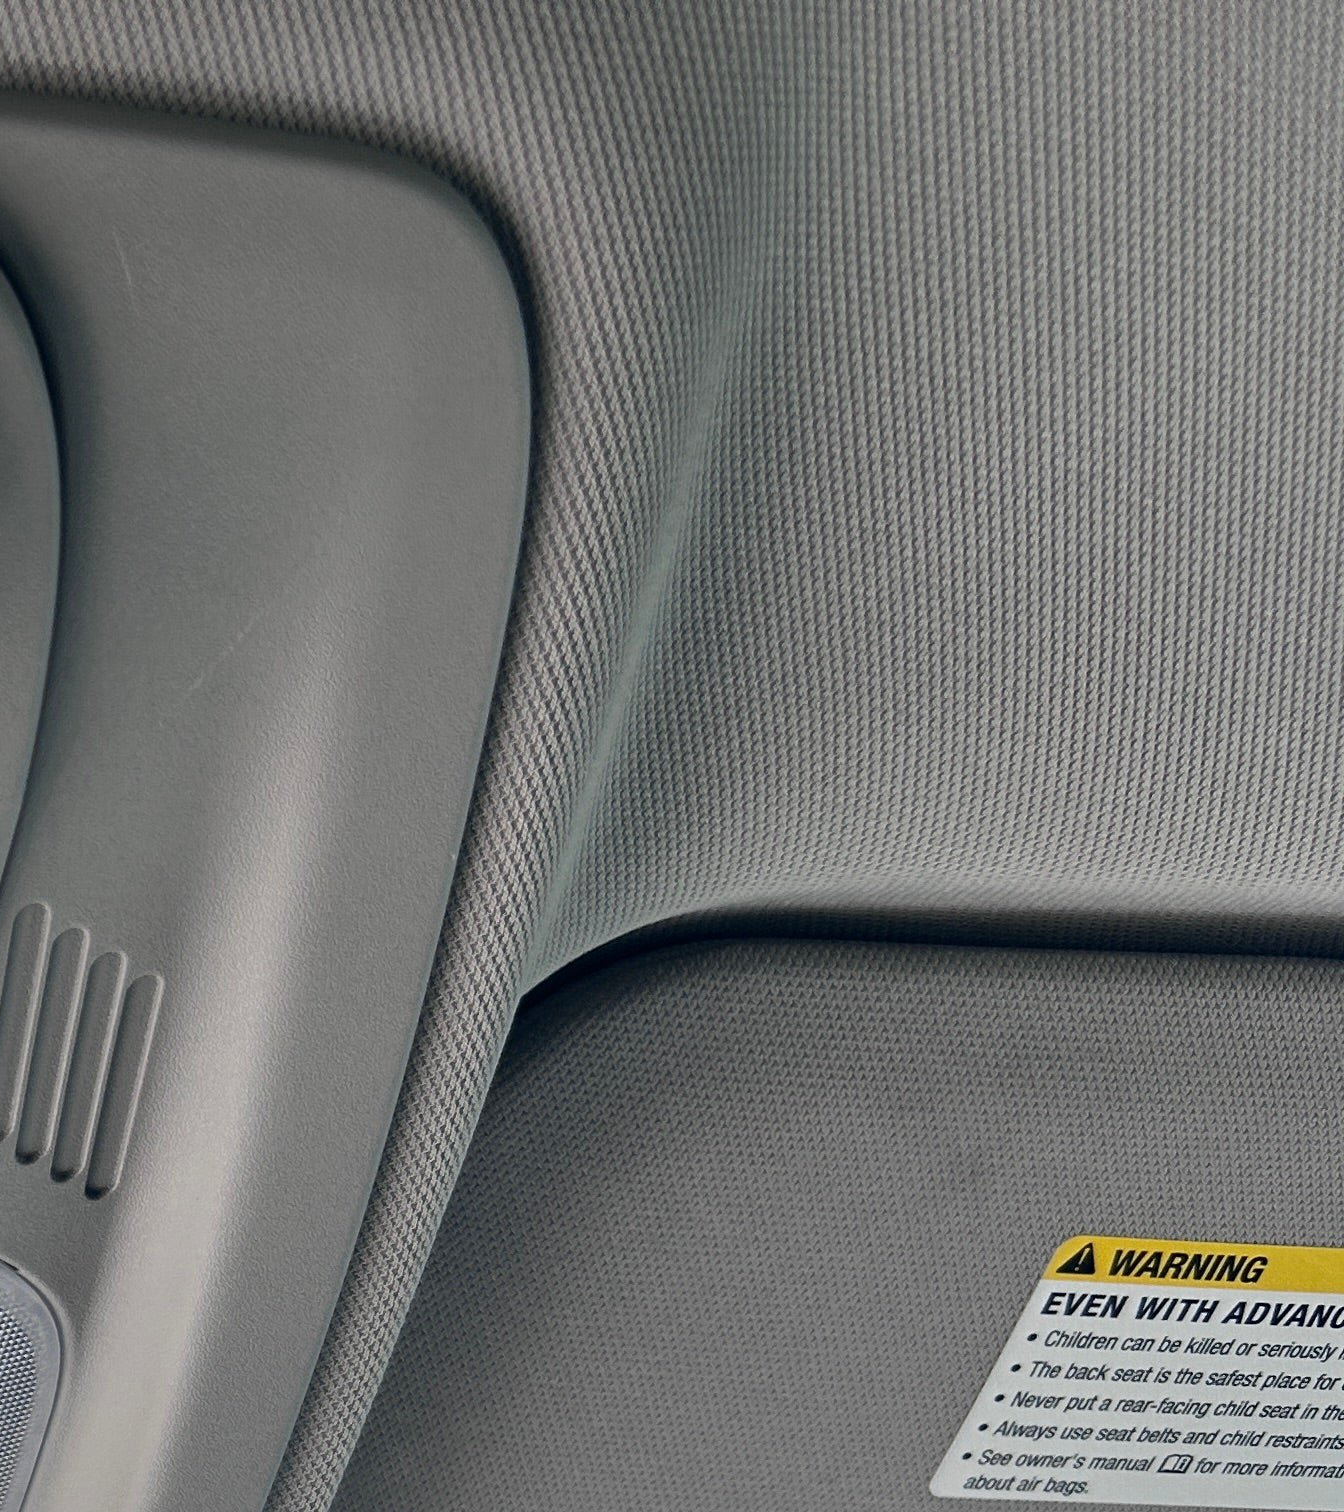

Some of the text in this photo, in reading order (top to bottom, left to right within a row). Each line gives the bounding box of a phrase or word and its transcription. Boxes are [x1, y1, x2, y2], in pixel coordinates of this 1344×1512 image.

[1108, 1249, 1269, 1284] WARNING
[1040, 1291, 1130, 1319] EVEN
[1134, 1296, 1219, 1323] WITH
[1044, 1329, 1119, 1351] Children
[1120, 1336, 1156, 1352] can
[1156, 1335, 1182, 1353] be
[1183, 1337, 1237, 1356] killed
[1235, 1342, 1258, 1356] or
[1257, 1341, 1339, 1363] seriously
[1029, 1361, 1063, 1379] The
[1064, 1363, 1112, 1381] back
[1111, 1366, 1155, 1383] seat
[1153, 1366, 1172, 1384] is
[1173, 1368, 1204, 1385] the
[1205, 1369, 1263, 1388] safest
[1259, 1371, 1312, 1391] place
[1313, 1373, 1342, 1391] for
[1010, 1391, 1066, 1410] Never
[1063, 1395, 1099, 1413] put
[1098, 1399, 1111, 1412] a
[1114, 1397, 1212, 1419] rear-facing
[1213, 1400, 1260, 1417] child
[1258, 1403, 1301, 1419] seat
[1299, 1404, 1320, 1419] in
[993, 1420, 1058, 1441] Always
[1059, 1426, 1094, 1441] use
[1095, 1427, 1137, 1444] seat
[1136, 1426, 1182, 1444] belts
[1182, 1429, 1221, 1446] and
[1219, 1429, 1266, 1447] child
[977, 1449, 1014, 1466] See
[1015, 1453, 1087, 1470] owner's
[1087, 1456, 1156, 1472] manual
[1194, 1457, 1222, 1474] for
[1221, 1462, 1269, 1476] more
[963, 1474, 1089, 1497] about air bags.
